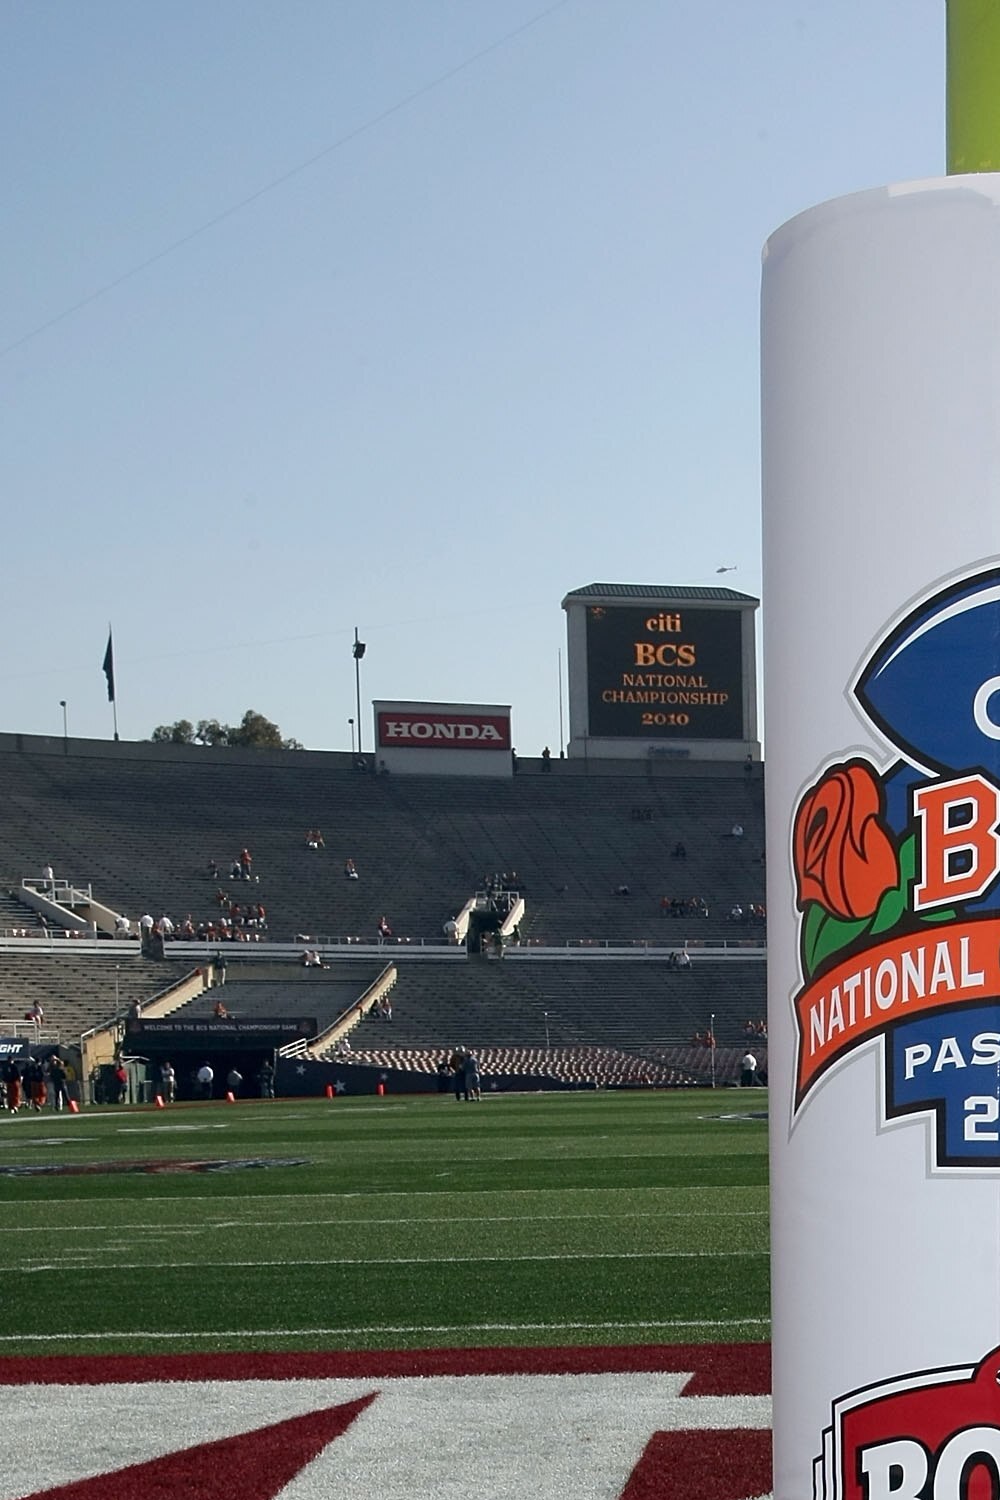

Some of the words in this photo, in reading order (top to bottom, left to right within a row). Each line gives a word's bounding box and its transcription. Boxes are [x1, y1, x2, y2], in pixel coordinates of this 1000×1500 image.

[645, 613, 682, 632] citi
[634, 643, 696, 667] BCS
[622, 673, 708, 689] NATIONAL
[601, 690, 729, 705] CHAMPIONSHIP
[641, 712, 690, 726] 2010
[385, 721, 504, 741] HONDA
[808, 937, 985, 1056] NATIONAL
